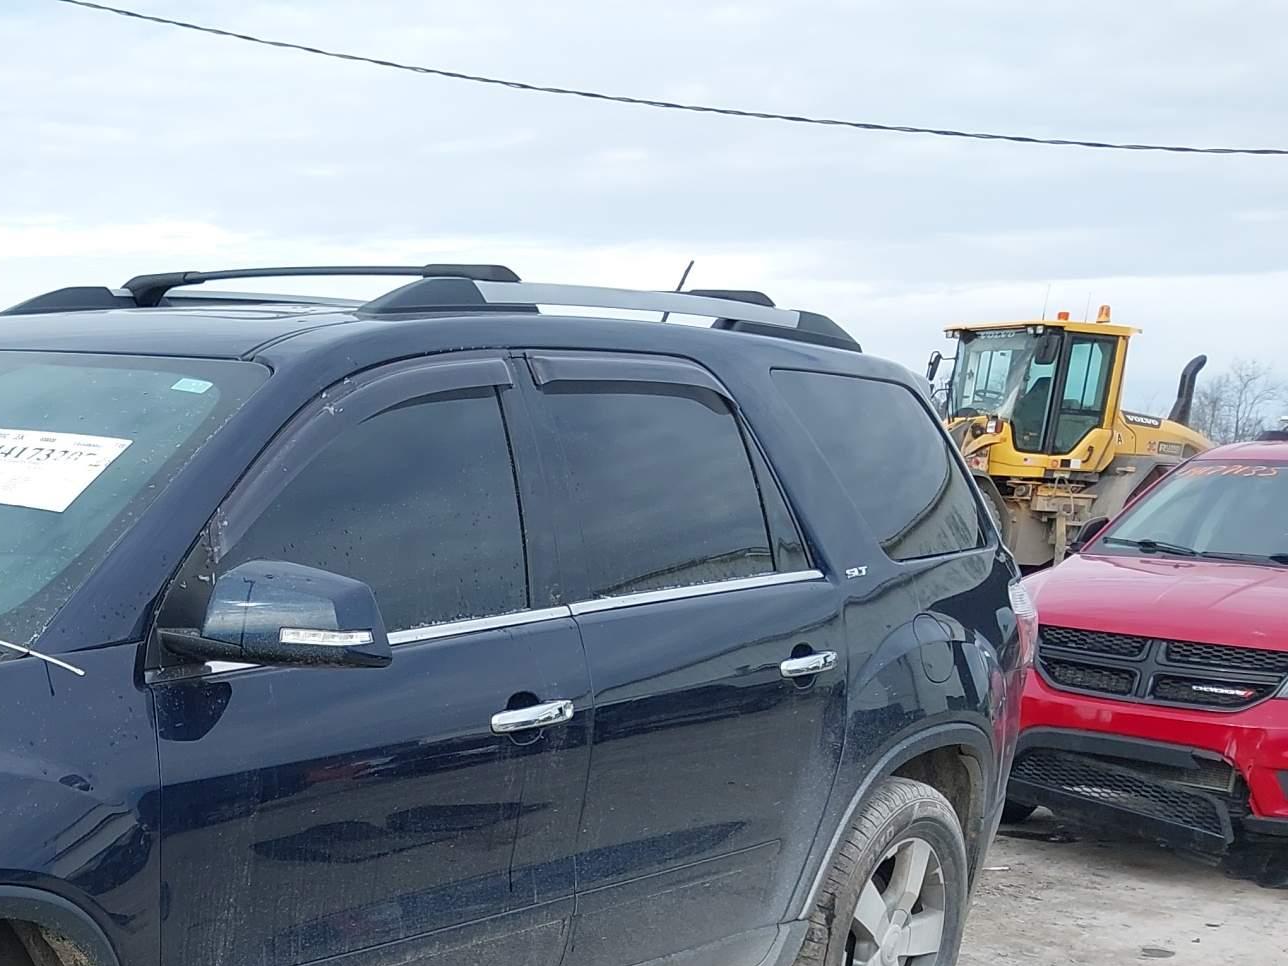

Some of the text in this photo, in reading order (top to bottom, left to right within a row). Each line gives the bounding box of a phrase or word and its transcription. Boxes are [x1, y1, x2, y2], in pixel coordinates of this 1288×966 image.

[1124, 414, 1160, 427] VOLVO
[845, 565, 868, 579] SLT
[1191, 684, 1247, 696] DODGE
